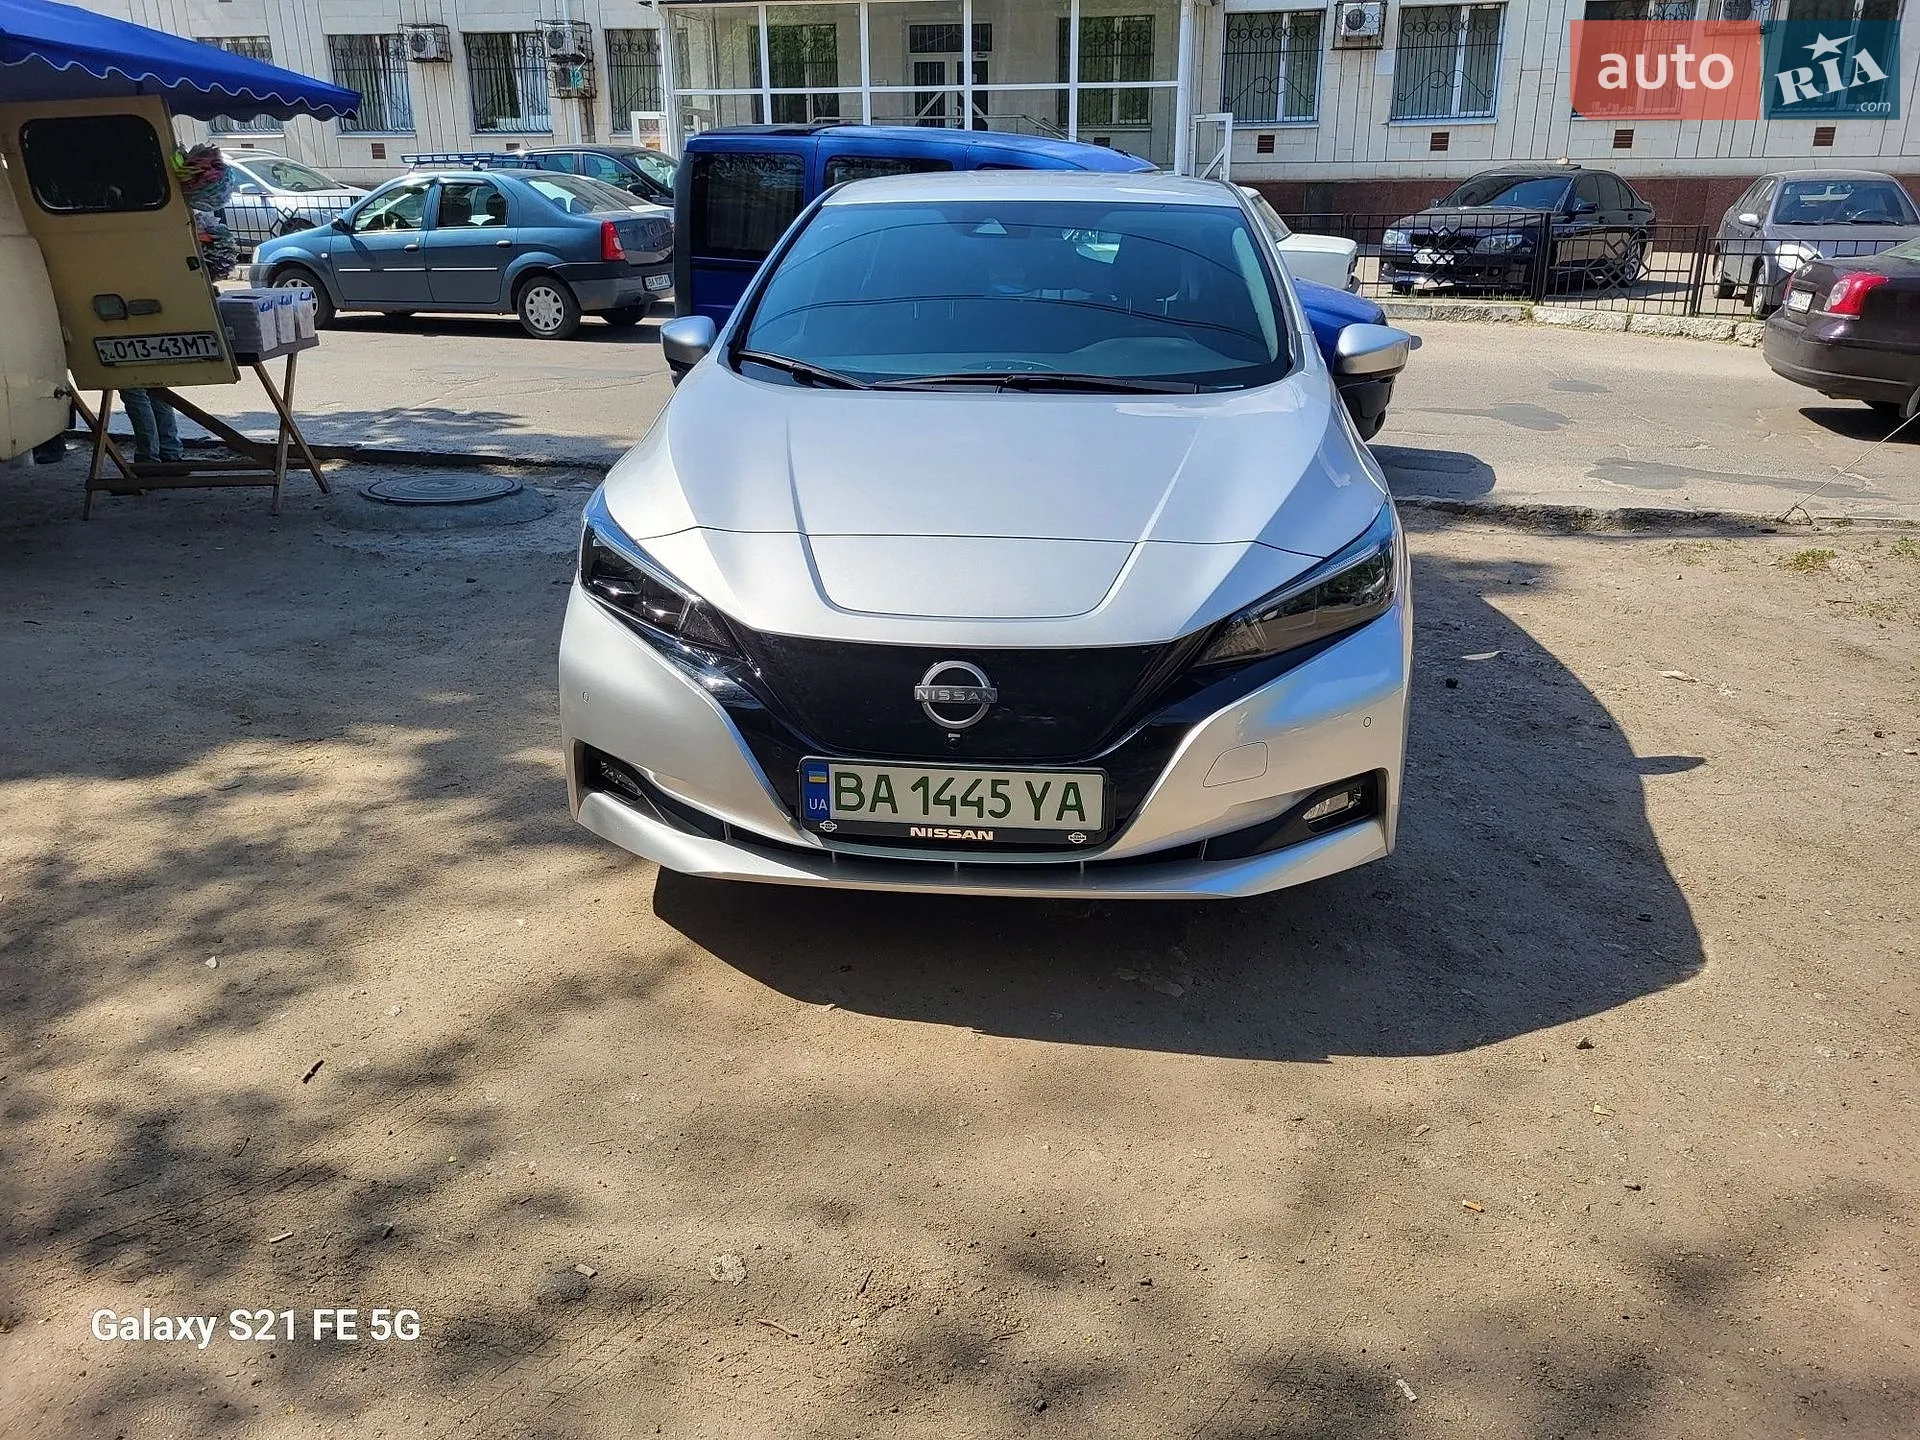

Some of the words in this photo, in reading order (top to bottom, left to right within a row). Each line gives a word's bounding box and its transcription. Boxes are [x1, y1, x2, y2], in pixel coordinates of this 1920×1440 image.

[914, 686, 998, 703] NISSAN
[809, 797, 828, 811] UA
[834, 771, 899, 814] BA
[910, 776, 1012, 819] 1445
[1025, 780, 1086, 822] YA
[910, 826, 994, 841] NISSAN
